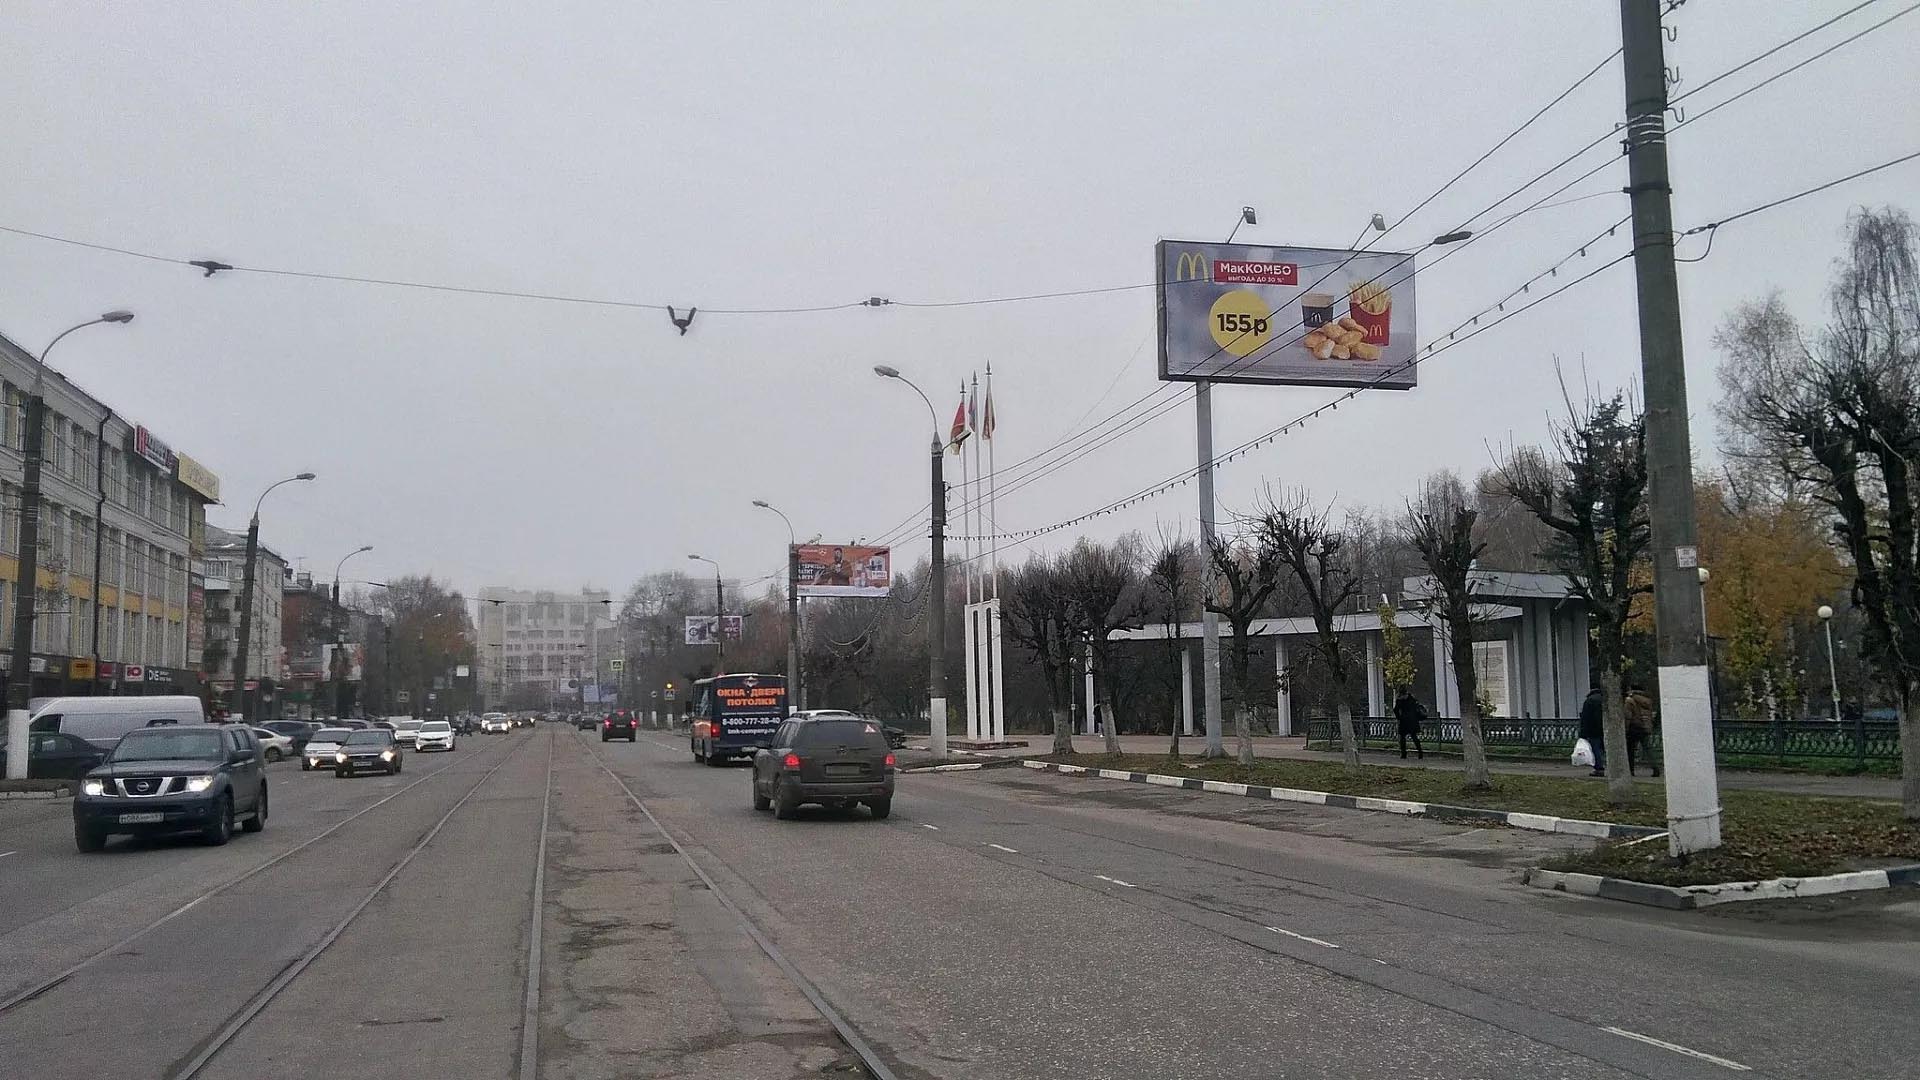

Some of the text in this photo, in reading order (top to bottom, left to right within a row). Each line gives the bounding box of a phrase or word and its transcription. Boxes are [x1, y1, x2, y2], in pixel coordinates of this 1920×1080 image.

[1220, 262, 1292, 276] МакКОМБО
[1216, 313, 1268, 337] 155р
[716, 688, 785, 697] ОКНА ДВЕРИ
[727, 698, 776, 706] ПОТОЛКИ
